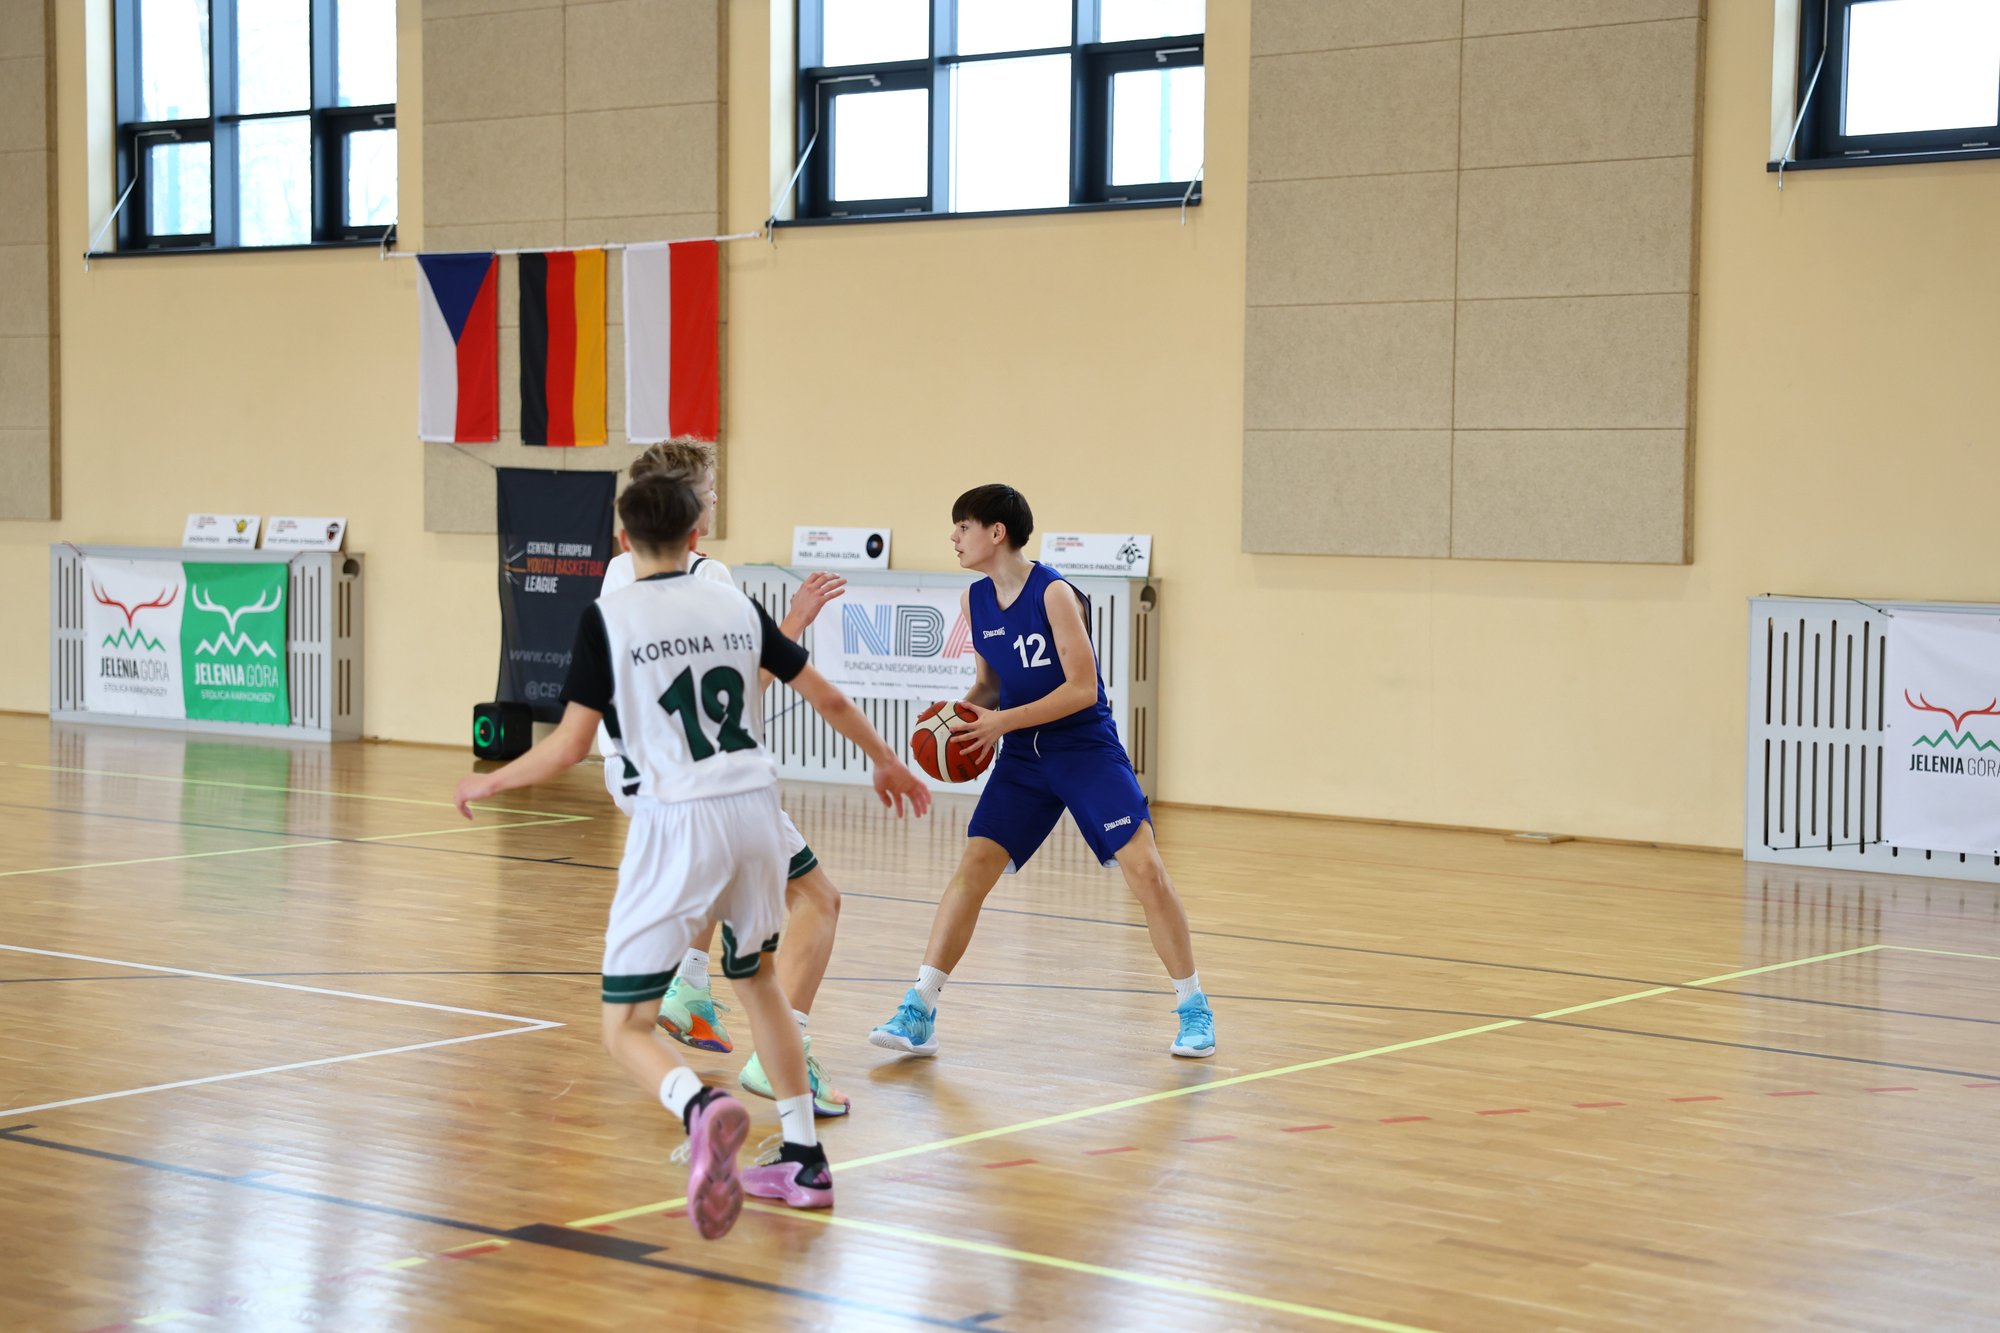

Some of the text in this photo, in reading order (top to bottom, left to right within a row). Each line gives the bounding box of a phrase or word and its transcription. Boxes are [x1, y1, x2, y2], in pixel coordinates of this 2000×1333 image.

[527, 541, 592, 557] CENTRAL EUROPEAN
[527, 557, 555, 574] YOUTH
[524, 575, 558, 594] LEAGUE
[982, 626, 1006, 639] SPALDING
[631, 633, 753, 666] KORONA 1919
[1013, 633, 1051, 668] 12
[100, 657, 140, 679] JELENIA
[195, 662, 245, 686] JELENIA
[844, 660, 883, 672] FUNDACJA
[927, 663, 958, 675] BASKET
[1909, 754, 1965, 775] JELENIA
[1103, 815, 1132, 832] SPALDING
